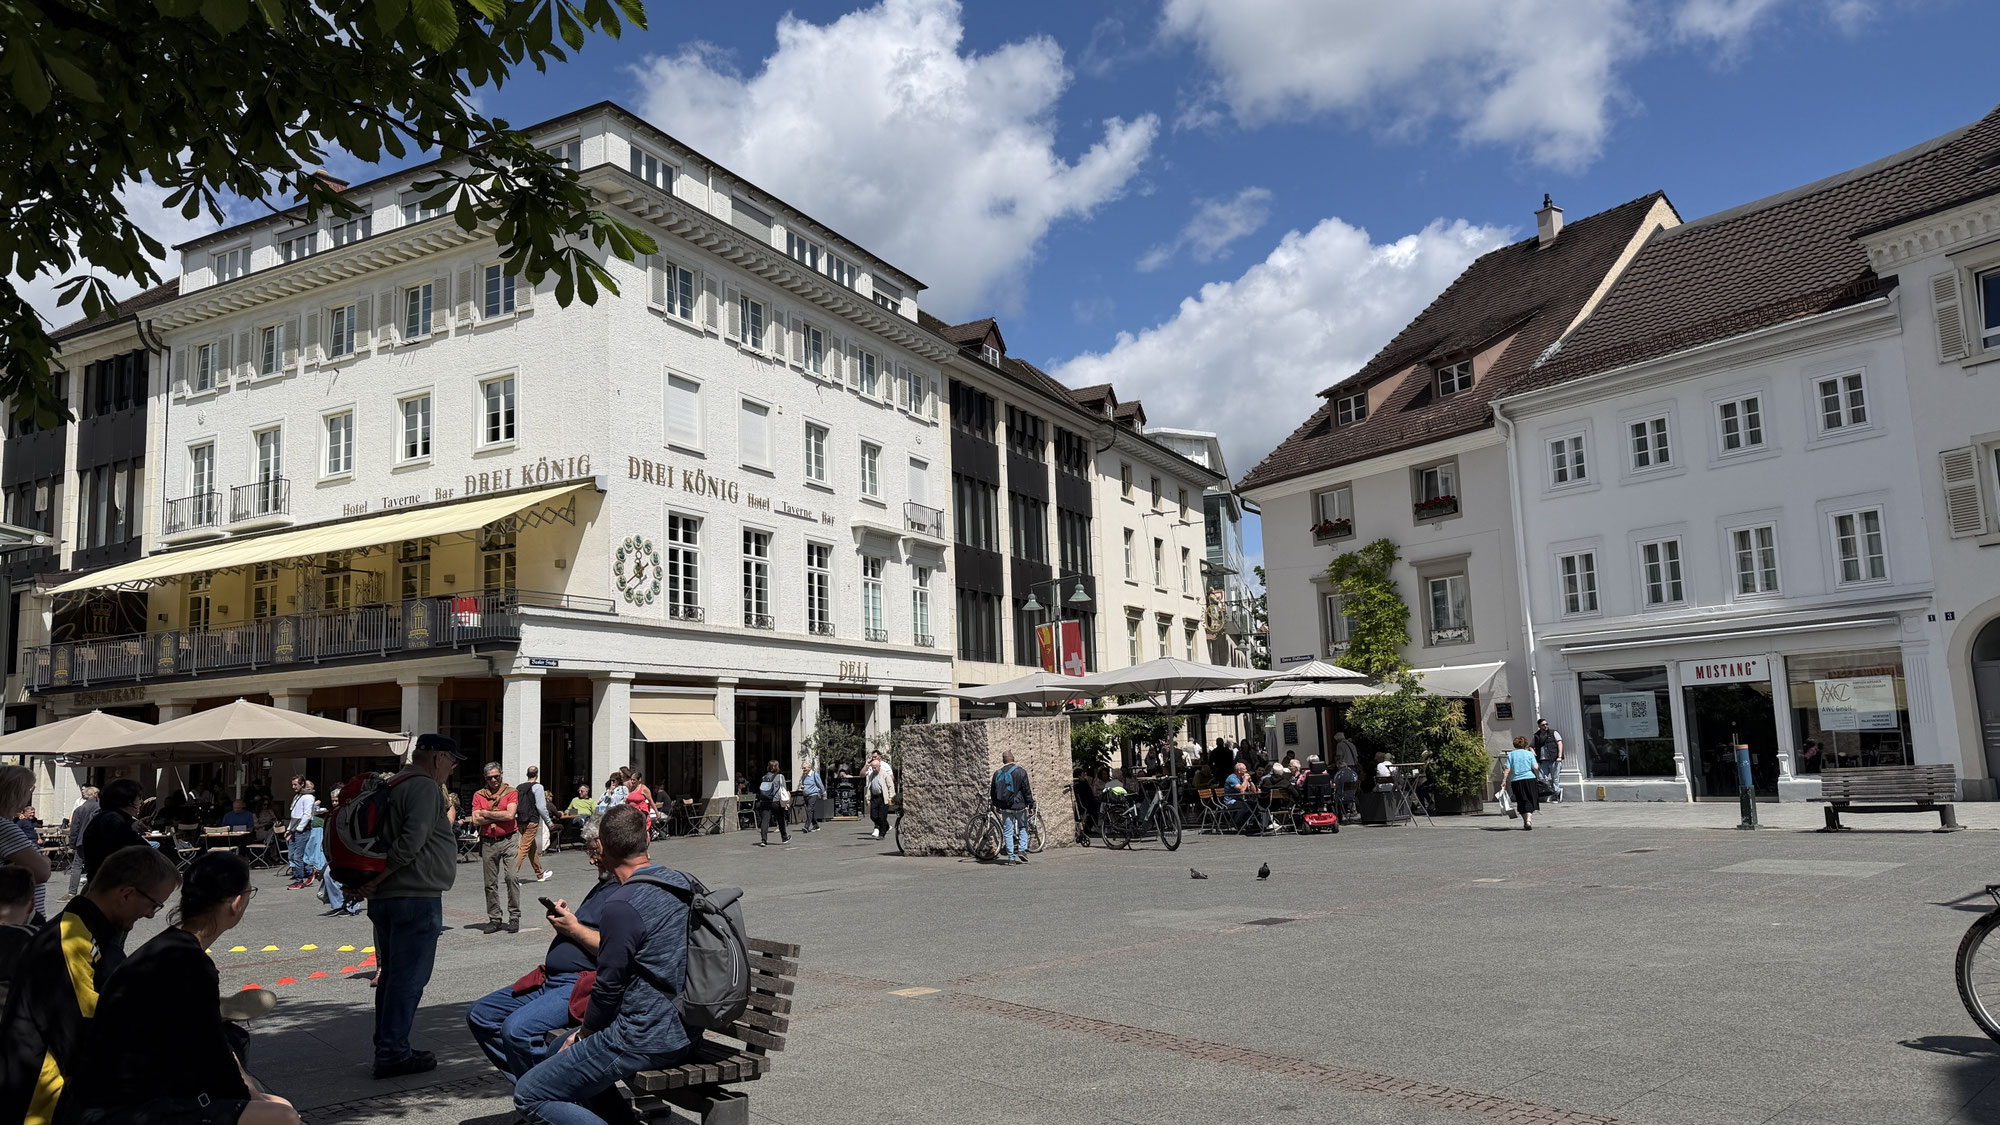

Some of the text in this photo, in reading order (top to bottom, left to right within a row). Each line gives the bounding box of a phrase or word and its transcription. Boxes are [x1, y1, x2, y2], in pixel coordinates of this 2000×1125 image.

[342, 454, 592, 517] Hotel Taverne Bar DREI KÖNIG
[627, 455, 836, 527] DREI KÖNIG Hotel Taverne Bar
[839, 660, 869, 681] DELI
